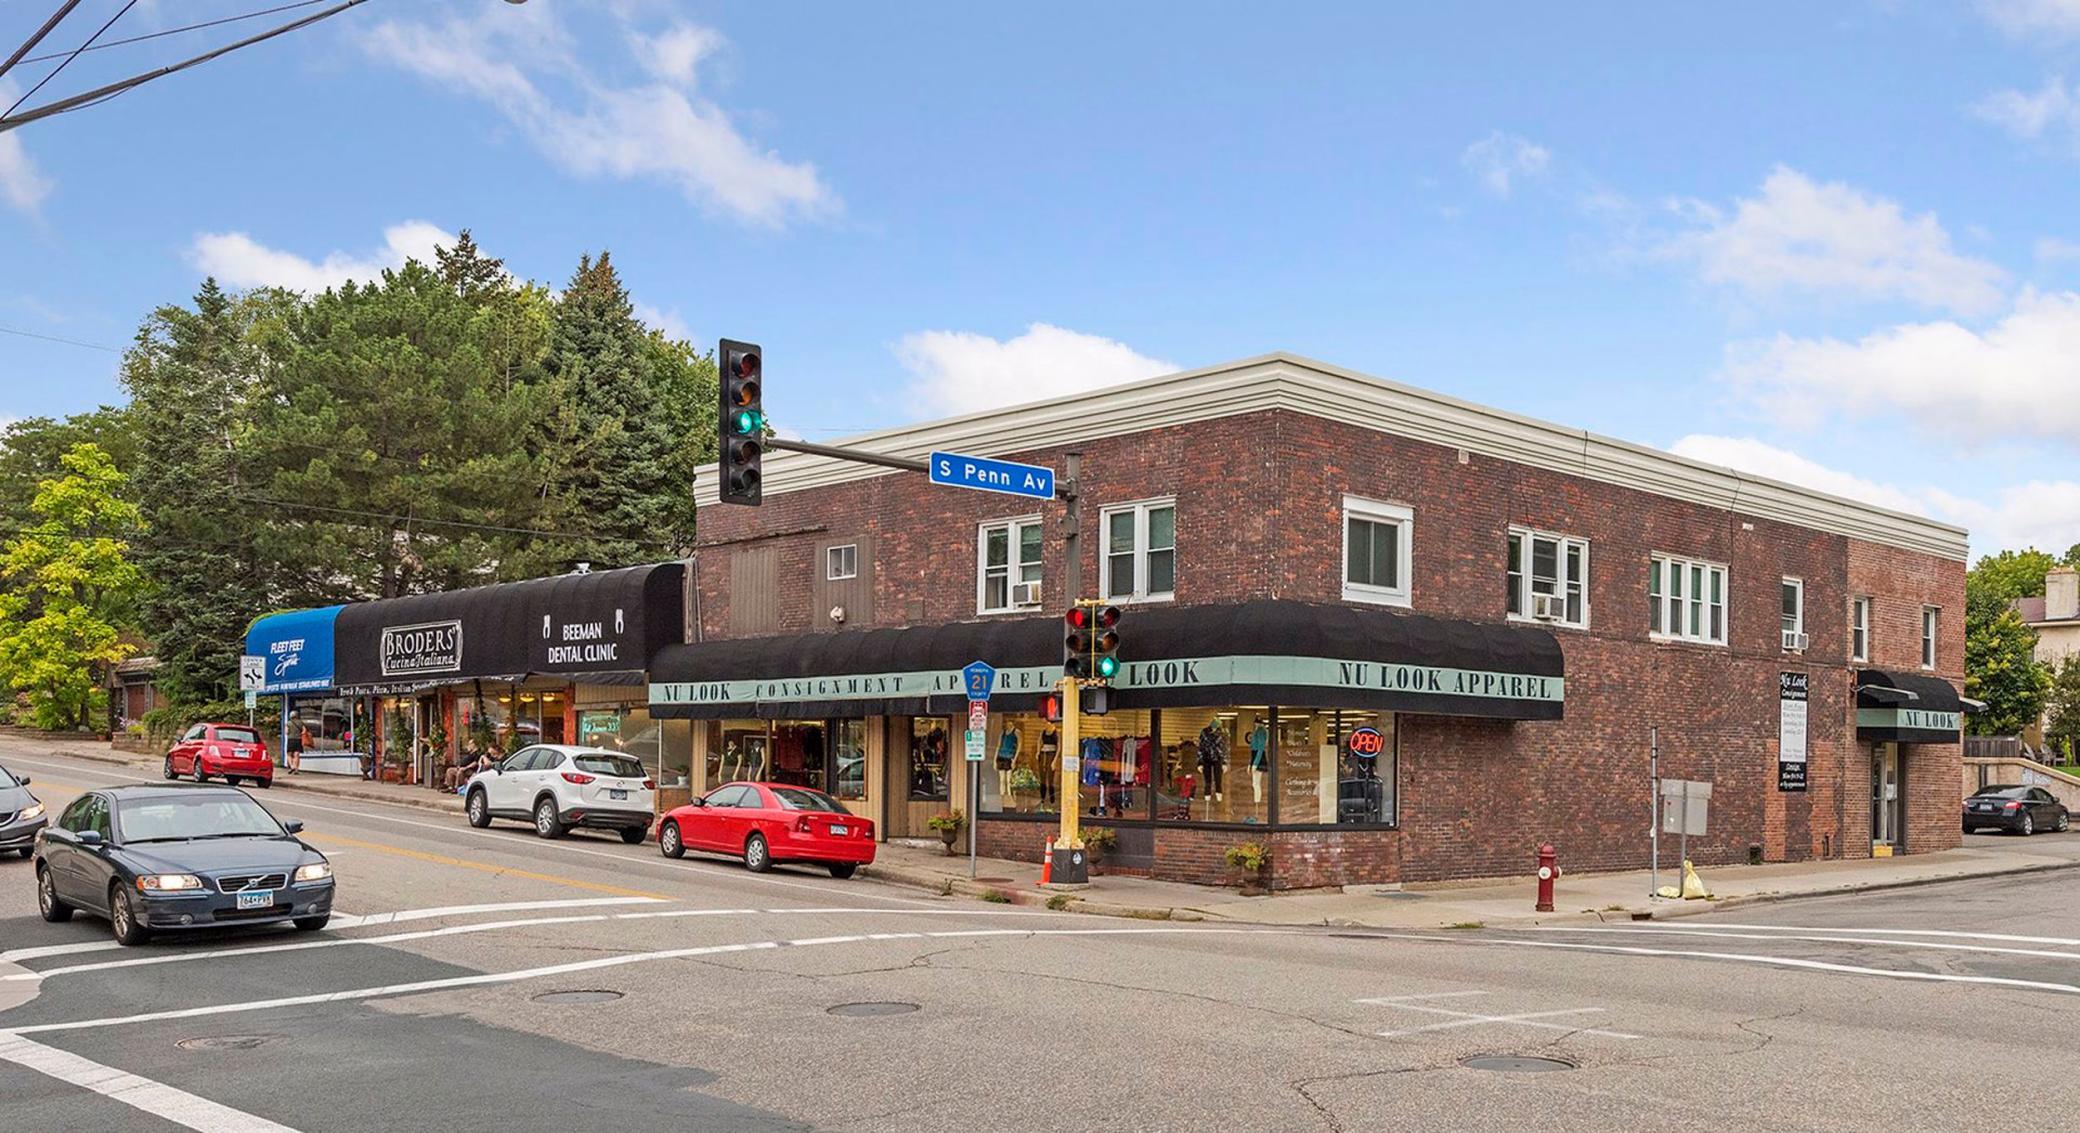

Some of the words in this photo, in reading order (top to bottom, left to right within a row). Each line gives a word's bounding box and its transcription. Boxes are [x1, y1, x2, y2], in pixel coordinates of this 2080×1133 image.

[940, 460, 951, 477] S
[964, 463, 1010, 486] Penn
[1023, 473, 1046, 491] Av
[563, 622, 602, 640] BEEMAN
[270, 641, 289, 654] FLEET
[289, 639, 305, 652] FEET
[548, 646, 583, 663] DENTAL
[585, 643, 618, 662] CLINIC
[386, 656, 415, 669] Cucina
[933, 671, 1048, 692] APREL
[971, 675, 987, 689] 21
[1129, 660, 1200, 687] LOOK
[1338, 662, 1368, 686] NU
[1379, 666, 1441, 692] LOOK
[1453, 671, 1551, 699] APPAREL
[663, 685, 682, 702] NU
[689, 683, 731, 701] LOOK
[756, 677, 904, 698] CONSIGNMENT
[1926, 712, 1953, 728] LOOK
[1350, 731, 1384, 753] OPEN
